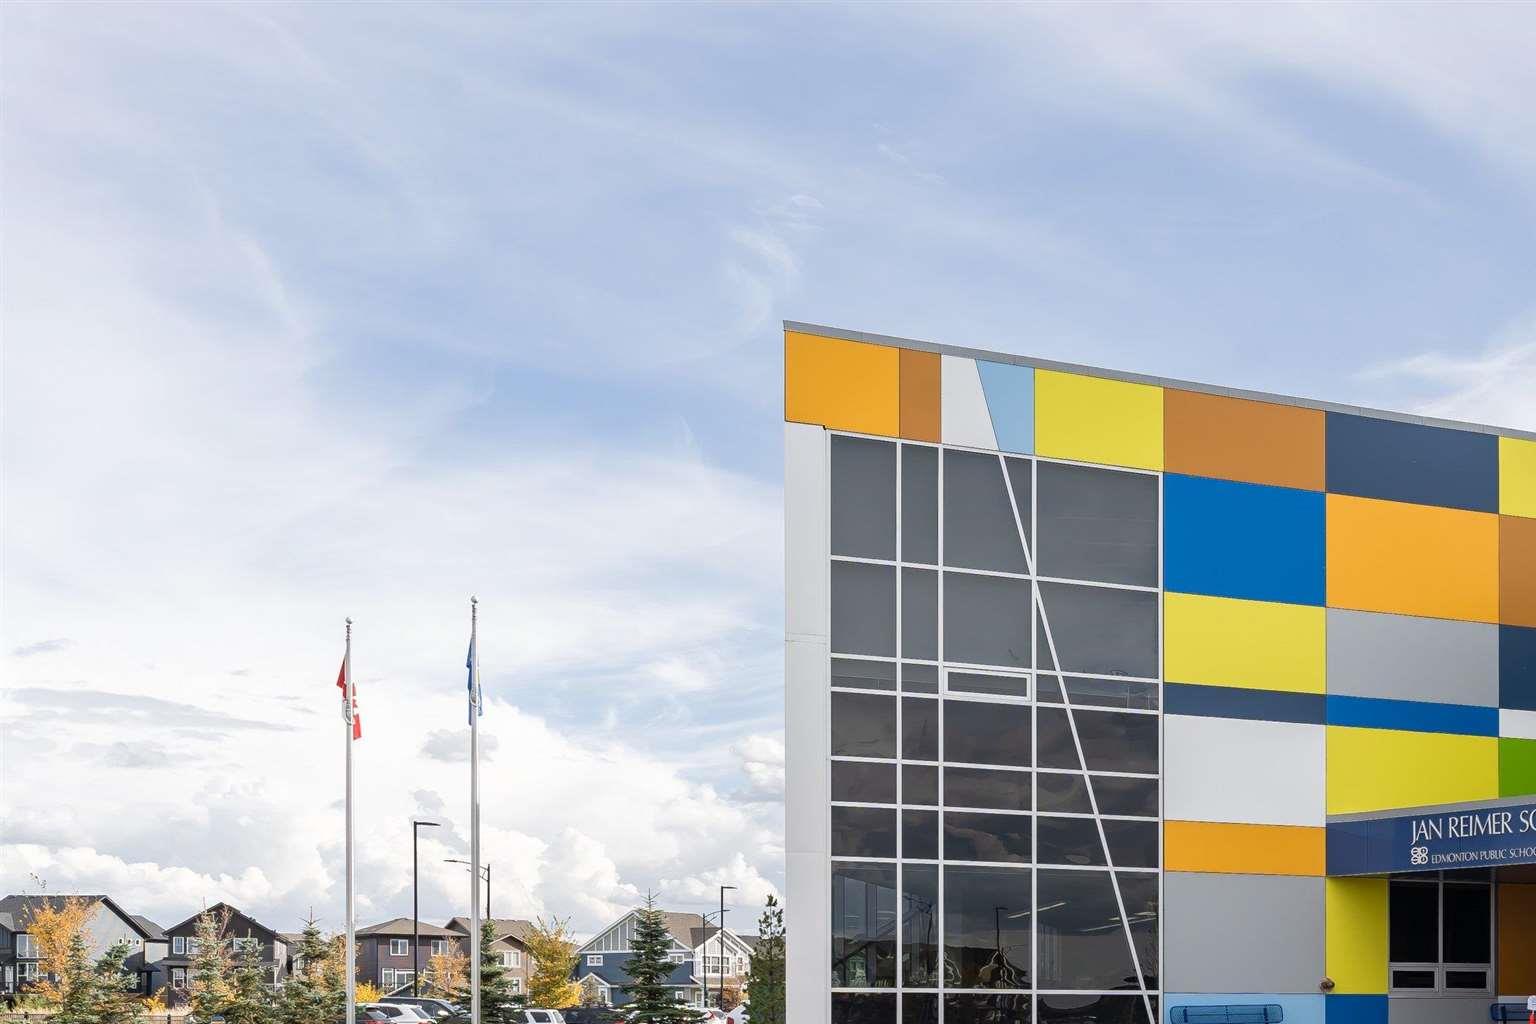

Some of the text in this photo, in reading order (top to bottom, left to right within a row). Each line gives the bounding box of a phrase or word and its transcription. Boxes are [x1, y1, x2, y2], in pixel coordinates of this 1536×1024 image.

[1410, 818, 1443, 845] JAN
[1448, 811, 1514, 838] REIMER
[1431, 851, 1479, 864] EDMONTON
[1479, 848, 1507, 861] PUBLIC
